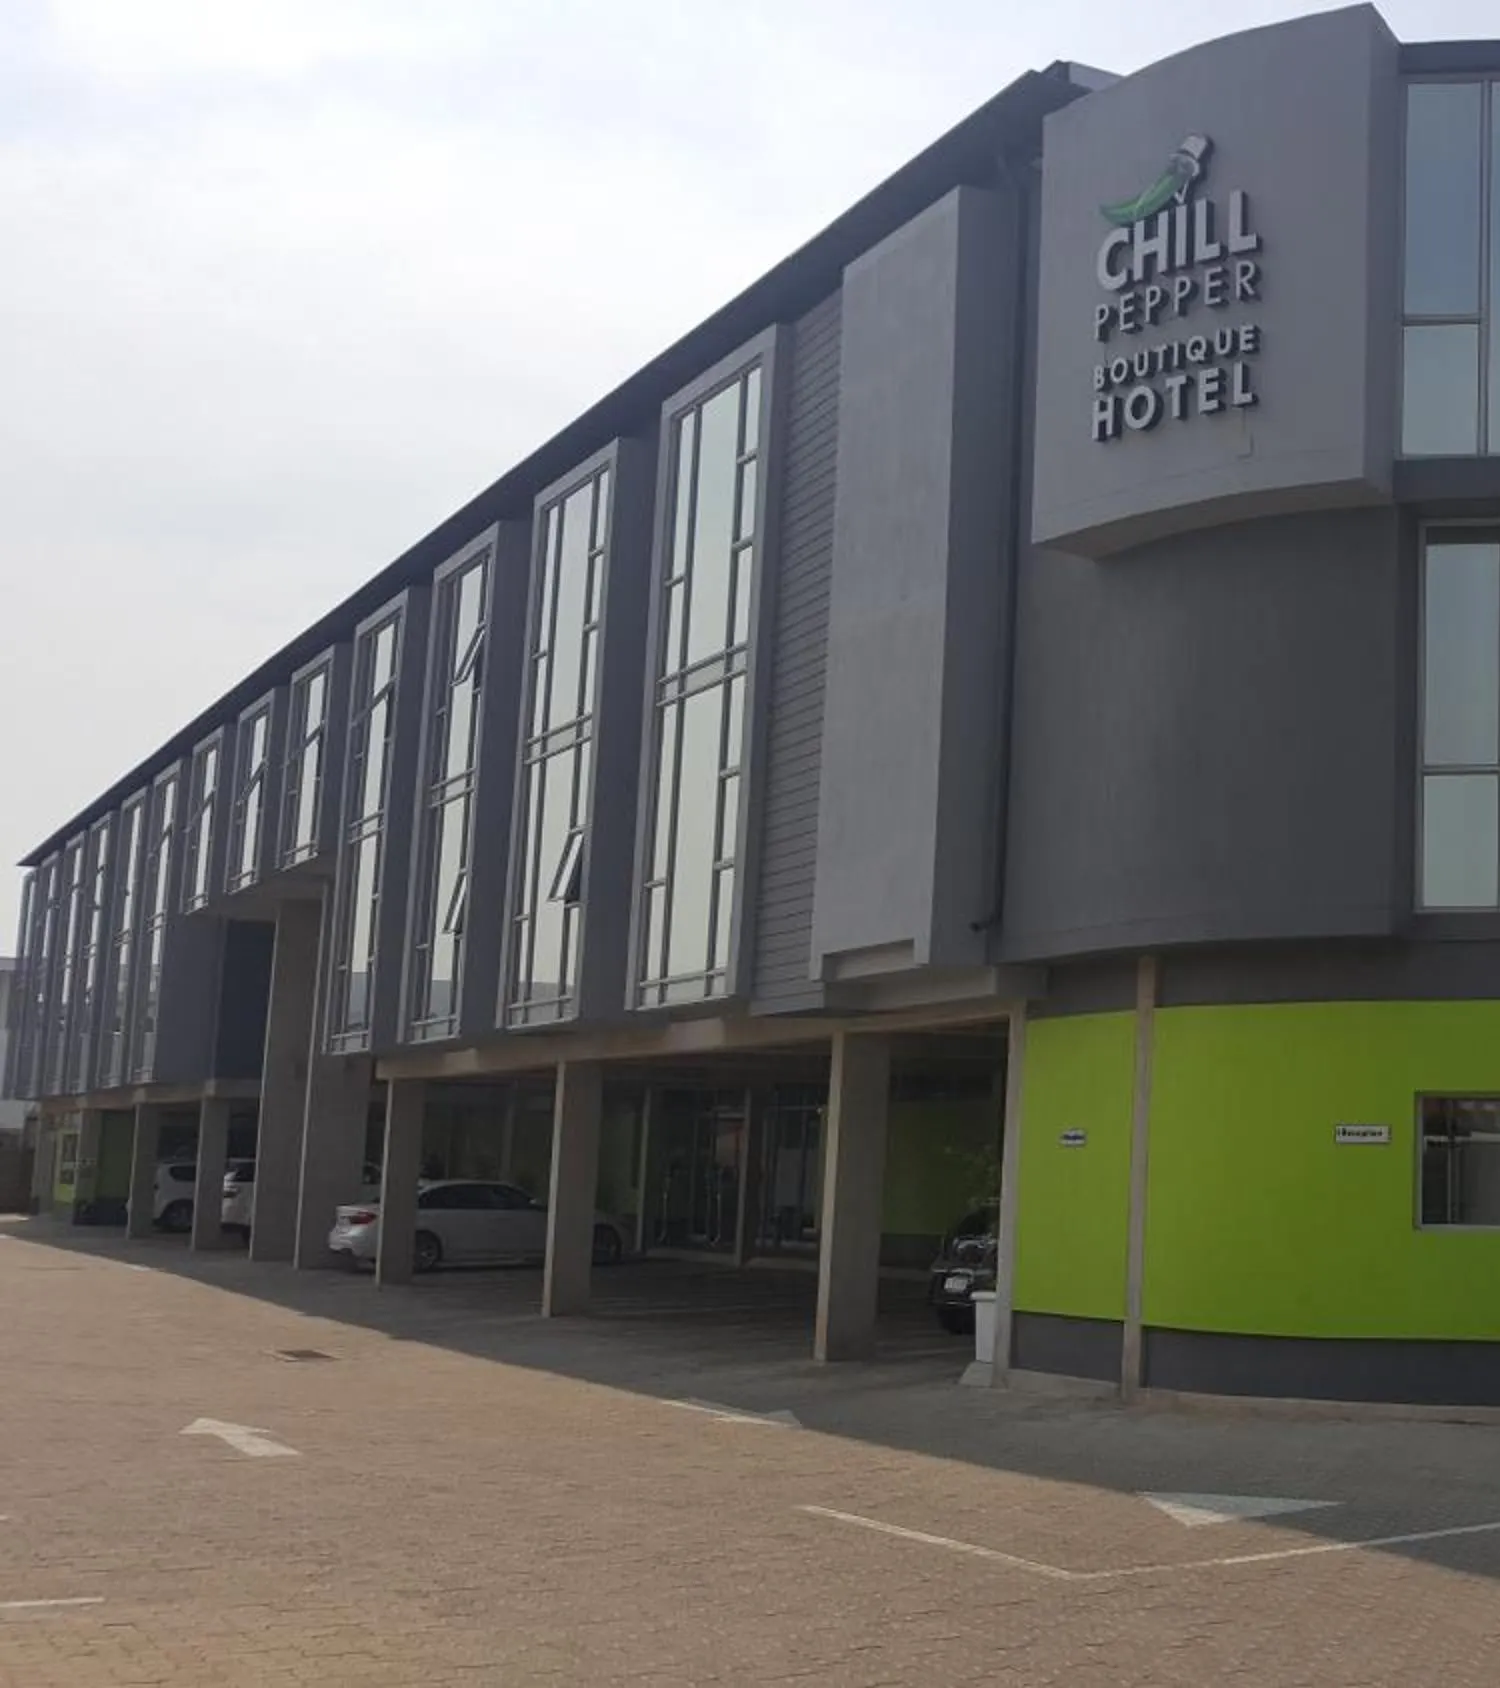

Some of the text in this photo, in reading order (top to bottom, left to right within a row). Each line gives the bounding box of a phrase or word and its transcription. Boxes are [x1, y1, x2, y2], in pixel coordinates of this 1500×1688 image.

[1098, 189, 1258, 290] CHILL
[1094, 260, 1256, 341] PEPPER
[1094, 324, 1257, 391] BOUTIQUE
[1091, 361, 1254, 440] HOTEL
